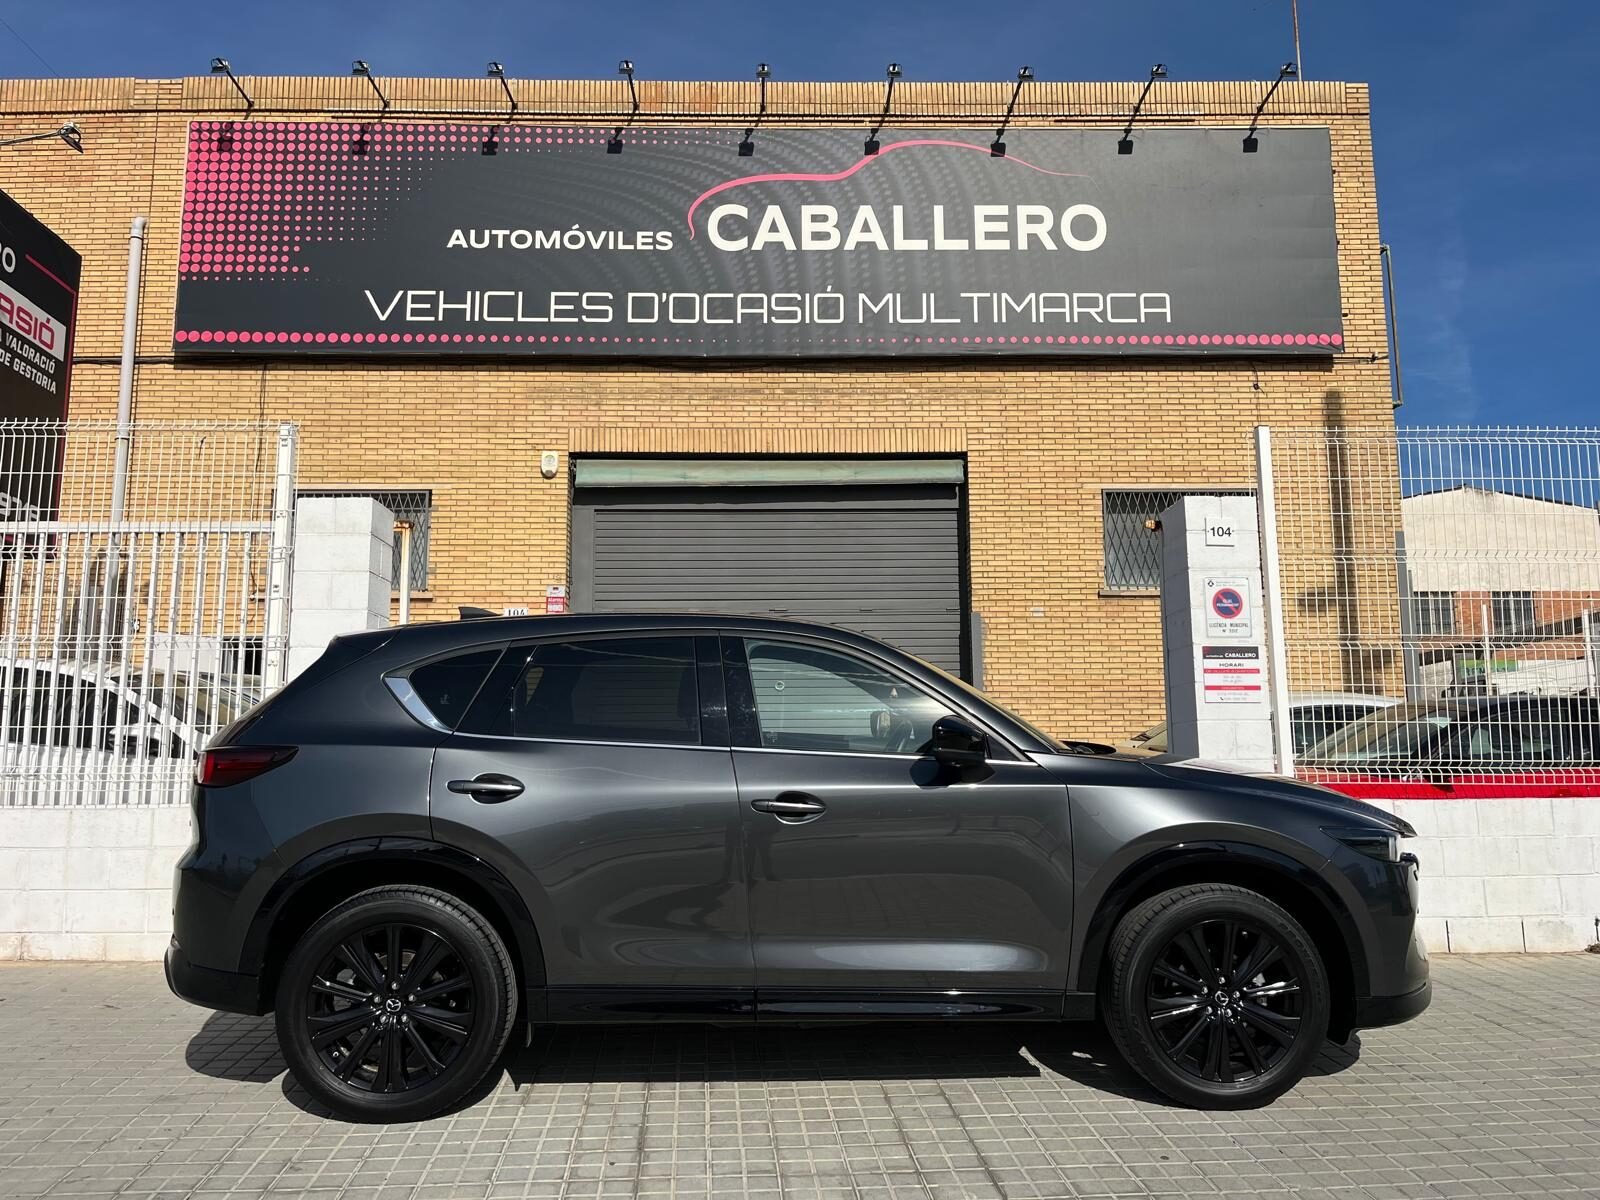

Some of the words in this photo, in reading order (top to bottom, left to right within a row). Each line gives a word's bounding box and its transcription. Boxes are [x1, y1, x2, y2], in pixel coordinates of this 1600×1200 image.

[447, 224, 673, 250] AUTOMÓVILES
[707, 203, 1107, 252] CABALLERO
[364, 290, 614, 323] VEHICLES
[627, 285, 845, 324] D'OCASIÓ
[858, 292, 1172, 324] MULTIMARCA
[5, 332, 56, 375] VALORACIÓ
[13, 357, 57, 395] GESTORIA
[1210, 526, 1232, 537] 104
